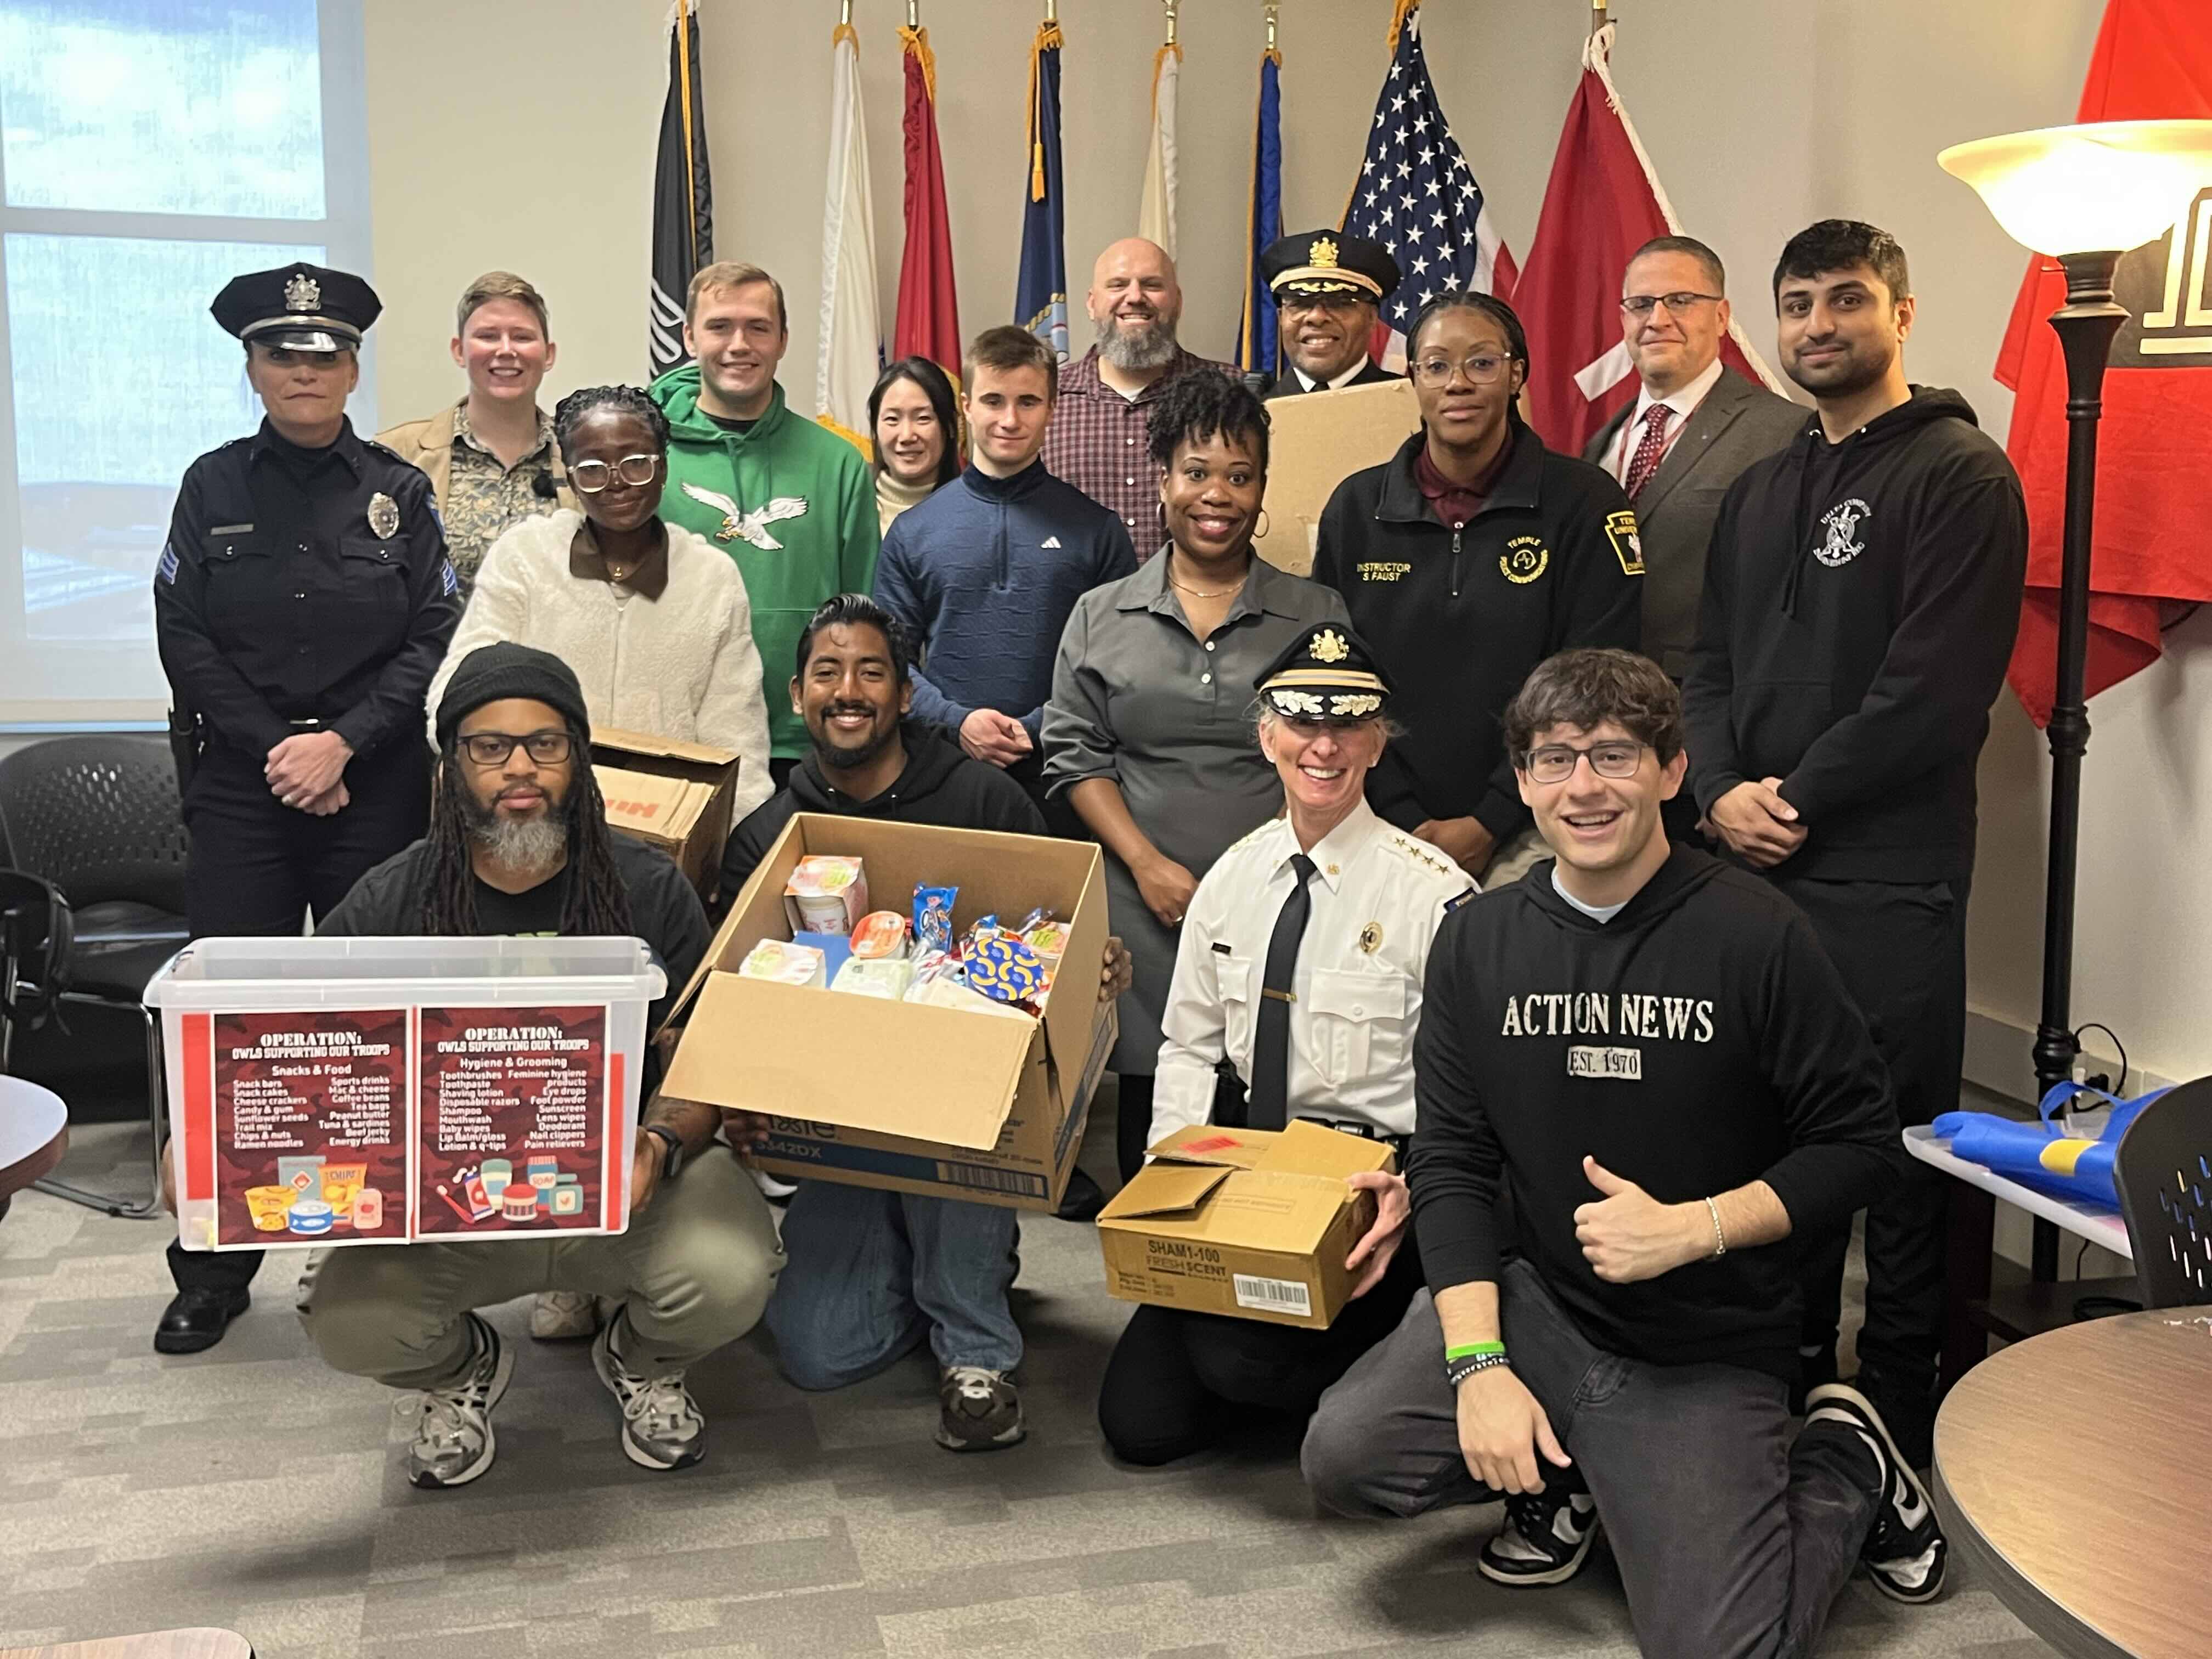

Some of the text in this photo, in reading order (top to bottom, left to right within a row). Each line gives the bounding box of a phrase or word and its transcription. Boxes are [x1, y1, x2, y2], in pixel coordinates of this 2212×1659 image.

[1508, 537, 1541, 549] TEMPLE
[1357, 563, 1411, 573] INSTRUCTOR
[1363, 572, 1401, 582] S FAUST
[1502, 992, 1713, 1042] ACTION NEWS
[465, 1026, 562, 1041] OPERATION:
[260, 1031, 362, 1047] OPERATION:
[438, 1039, 589, 1053] OWLS SUPPORTING OUR TROOPS
[232, 1044, 390, 1060] OWLS SUPPORTING OUR TROOPS
[460, 1056, 567, 1071] Hygiene & Grooming
[1570, 1051, 1638, 1075] EST. 1970
[272, 1064, 352, 1076] Snacks & Food
[508, 1069, 587, 1080] Feminine hygiene
[439, 1071, 503, 1080] Toothbrushes
[233, 1080, 283, 1088] Snack bars
[331, 1076, 390, 1086] Sports drinks
[439, 1080, 490, 1090] Toothpaste
[546, 1079, 587, 1088] products
[233, 1088, 289, 1097] Snack cakes
[329, 1085, 390, 1094] Mac & cheese
[439, 1088, 504, 1098] Shaving lotion
[543, 1087, 586, 1097] Eye drops
[234, 1096, 308, 1106] Cheese crackers
[332, 1094, 390, 1103] Coffee beans
[439, 1098, 520, 1108] Disposable razors
[531, 1096, 586, 1105] Foot powder
[234, 1105, 294, 1115] Candy & gum
[351, 1102, 390, 1111] Tea bags
[439, 1107, 482, 1116] Shampoo
[538, 1104, 586, 1113] Sunscreen
[234, 1113, 309, 1124] Sunflower seeds
[329, 1111, 391, 1120] Peanut butter
[439, 1115, 492, 1124] Mouthwash
[536, 1113, 586, 1123] Lens wipes
[234, 1123, 273, 1132] Trail mix
[318, 1119, 390, 1129] Tuna & sardines
[439, 1124, 490, 1134] Baby wipes
[538, 1122, 585, 1131] Deodorant
[234, 1131, 292, 1142] Chips & nuts
[439, 1133, 454, 1143] Lip
[529, 1130, 586, 1141] Nail clippers
[267, 1139, 304, 1148] noodles
[329, 1136, 390, 1147] Energy drinks
[439, 1142, 468, 1151] Lotion
[469, 1141, 477, 1150] &
[524, 1139, 585, 1149] Pain relievers
[1148, 1240, 1221, 1263] SHAM1-100
